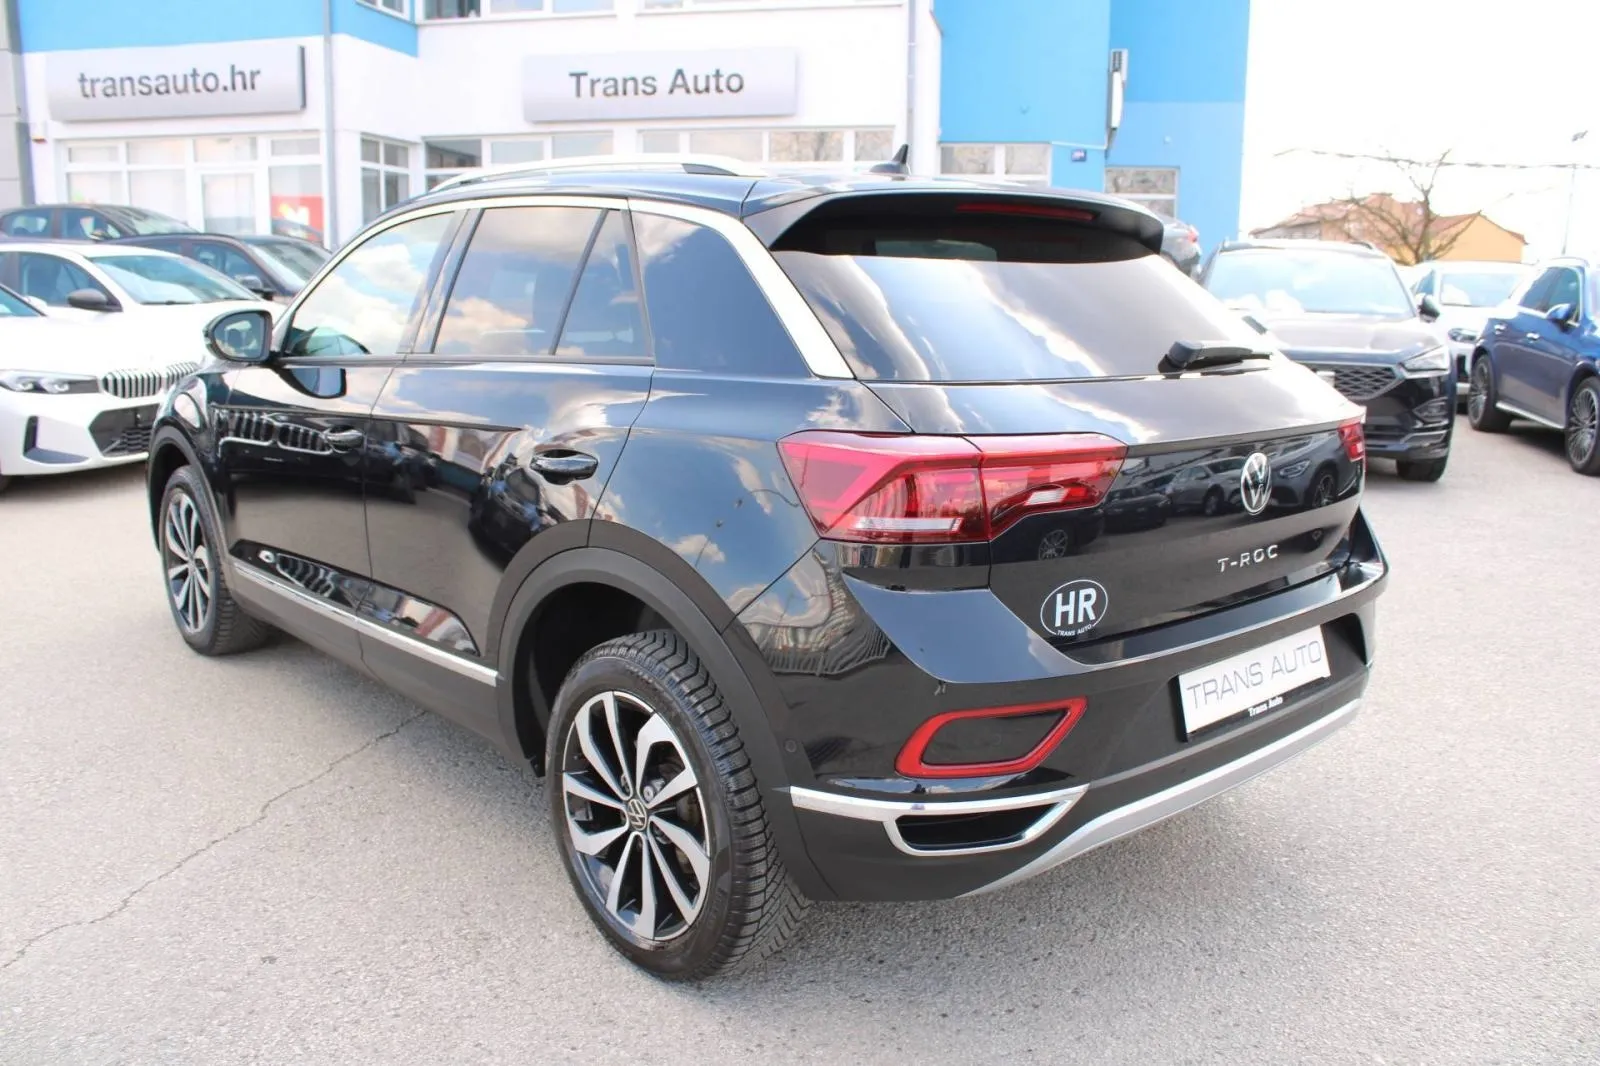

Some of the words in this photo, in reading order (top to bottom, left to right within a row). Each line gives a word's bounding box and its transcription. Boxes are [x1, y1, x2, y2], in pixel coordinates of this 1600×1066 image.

[78, 64, 261, 99] transauto.hr
[568, 70, 658, 99] Trans
[668, 67, 745, 95] Auto
[1217, 544, 1279, 573] T-ROC
[1054, 587, 1097, 628] HR
[1057, 629, 1076, 638] TRANS
[1076, 623, 1093, 636] AUTO
[1187, 661, 1264, 709] TRANS
[1270, 640, 1323, 680] AUTO
